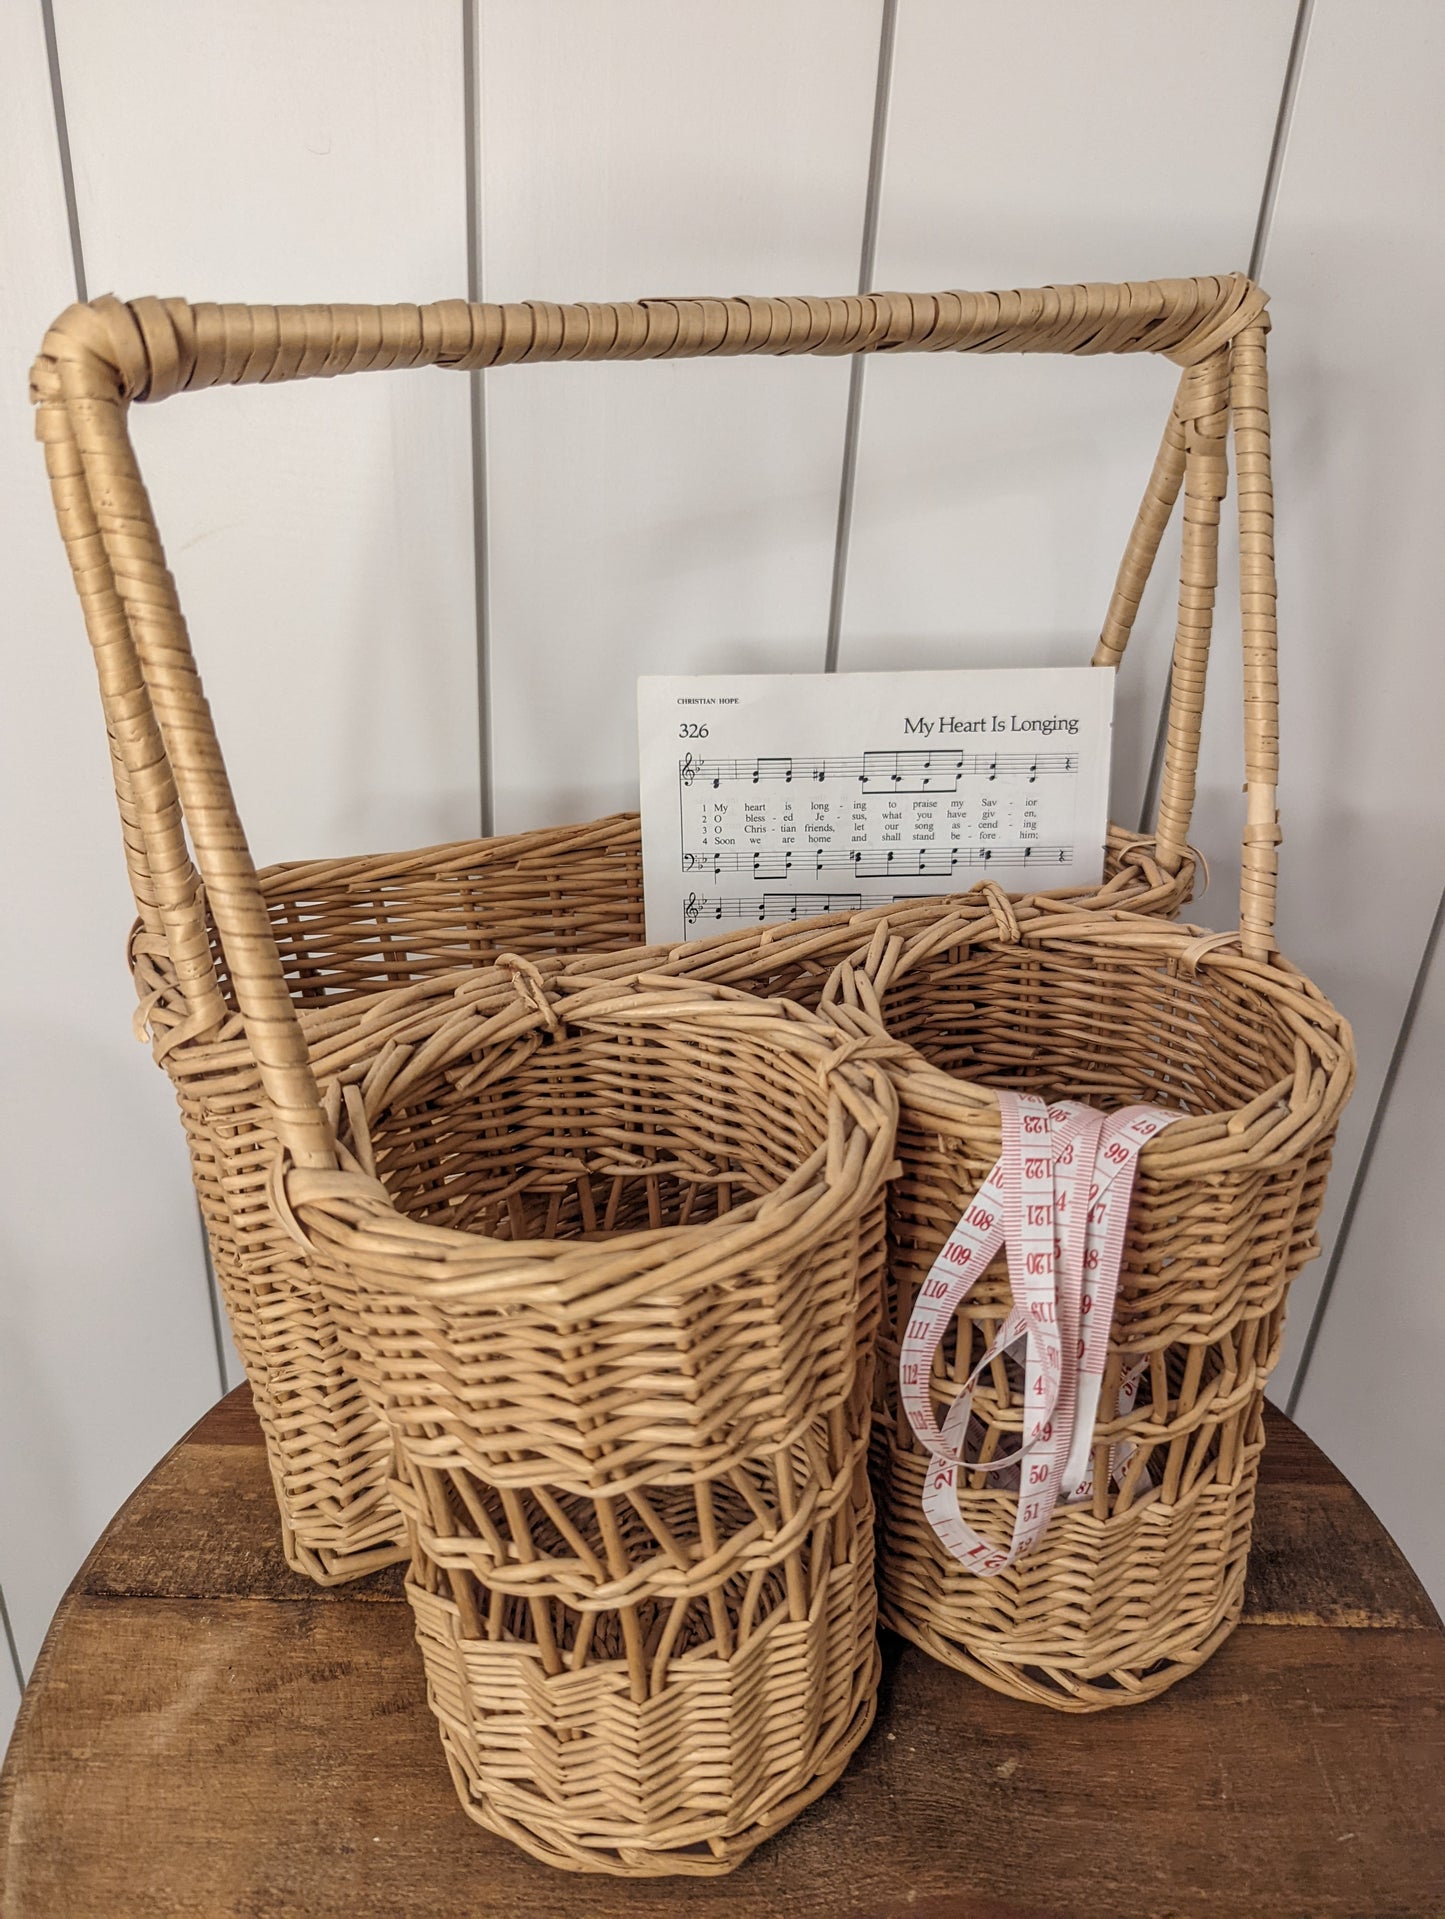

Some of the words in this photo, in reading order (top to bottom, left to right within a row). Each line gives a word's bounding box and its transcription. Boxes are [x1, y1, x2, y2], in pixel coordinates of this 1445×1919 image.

[719, 697, 739, 705] HOPE
[679, 723, 709, 739] 326
[904, 716, 934, 738] My
[938, 715, 987, 734] Heart
[991, 714, 1006, 733] Is
[1010, 714, 1079, 736] Longing
[714, 803, 728, 815] My
[744, 802, 766, 812] heart
[784, 801, 792, 811] is
[811, 801, 829, 813] long
[853, 801, 867, 813] ing
[888, 800, 897, 809] to
[912, 799, 938, 812] praise
[950, 800, 964, 811] my
[981, 798, 998, 807] Sav
[1025, 797, 1038, 806] ior
[702, 815, 708, 824] 2
[714, 815, 723, 824] O
[745, 813, 766, 823] bless
[783, 812, 794, 822] ed
[814, 812, 825, 821] Je
[852, 813, 868, 822] sus,
[881, 811, 902, 820] what
[916, 812, 933, 821] you
[946, 810, 967, 819] have
[982, 810, 996, 820] giv
[702, 826, 708, 835] 3
[714, 825, 723, 834] O
[744, 824, 767, 834] Chris
[780, 824, 797, 833] tian
[804, 823, 836, 834] friends,
[853, 822, 865, 832] let
[884, 823, 899, 831] our
[914, 822, 934, 833] song
[951, 822, 961, 830] as
[978, 820, 998, 830] cend
[1023, 820, 1037, 831] ing
[702, 837, 708, 846] 4
[714, 836, 736, 846] Soon
[749, 837, 762, 845] we
[781, 837, 796, 845] are
[808, 835, 832, 844] home
[851, 834, 867, 843] and
[881, 832, 901, 841] shall
[912, 832, 935, 841] stand
[950, 831, 961, 841] be
[979, 831, 996, 841] fore
[1023, 1115, 1050, 1134] 123
[1131, 1119, 1157, 1136] 67
[988, 1165, 1004, 1190] 10
[1025, 1158, 1053, 1180] 122
[964, 1204, 995, 1232] 108
[1027, 1204, 1053, 1227] 121
[941, 1241, 972, 1267] 109
[1026, 1252, 1053, 1276] 120
[922, 1278, 949, 1300] 110
[1030, 1301, 1056, 1323] 119
[907, 1319, 931, 1341] 111
[902, 1363, 918, 1385] 112
[1033, 1375, 1045, 1396] 4
[1029, 1464, 1049, 1485] 50
[1023, 1502, 1040, 1523] 51
